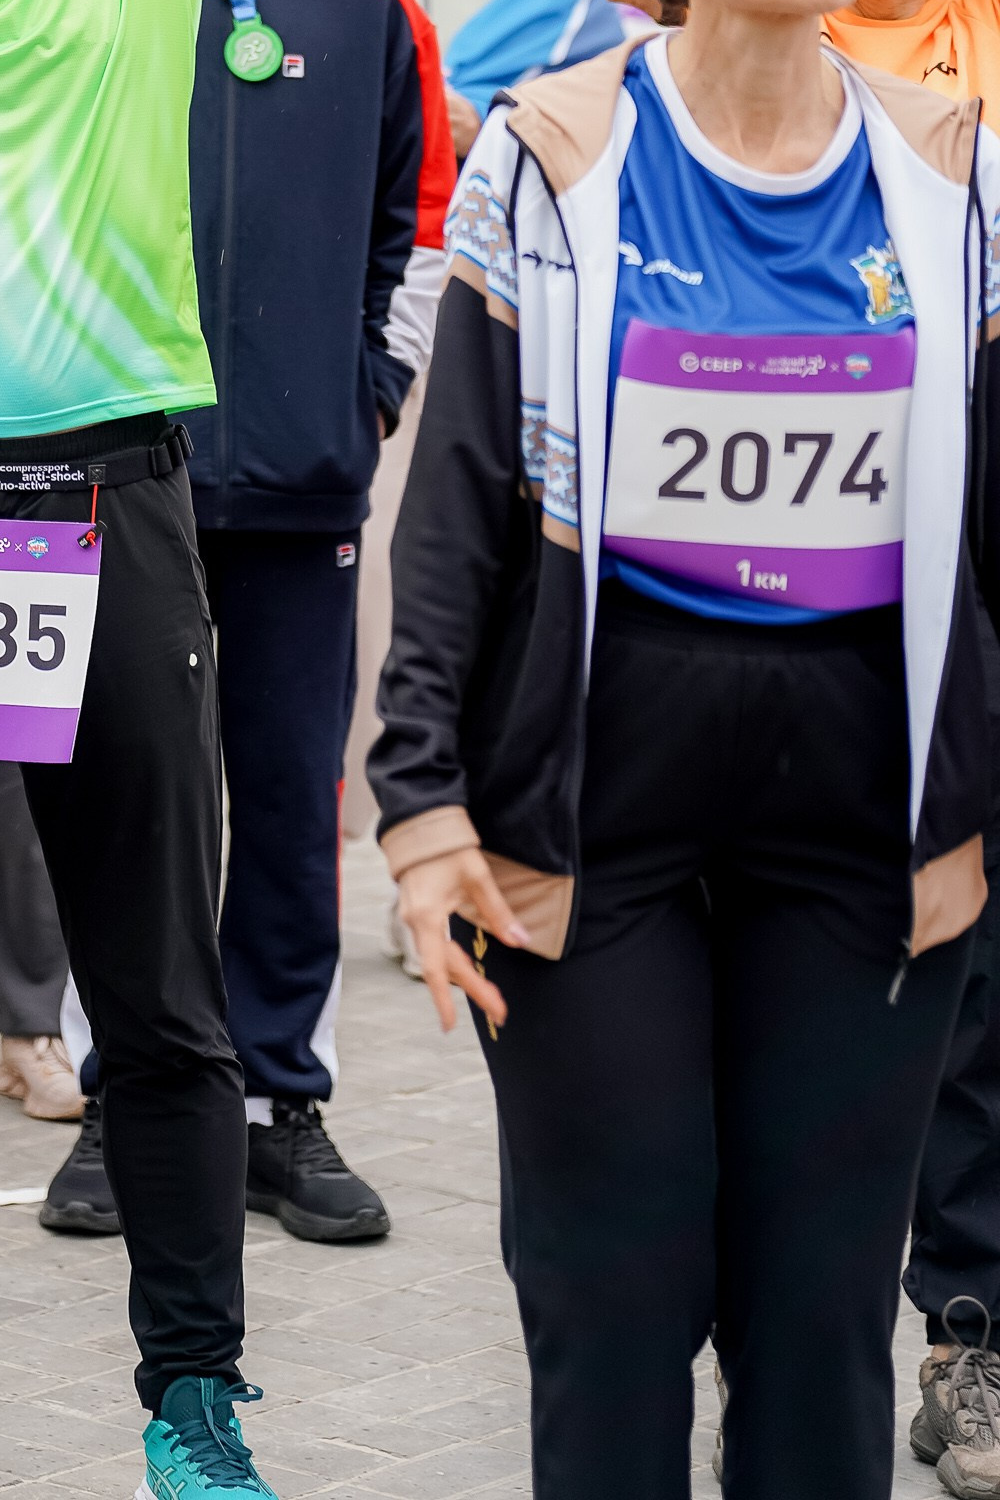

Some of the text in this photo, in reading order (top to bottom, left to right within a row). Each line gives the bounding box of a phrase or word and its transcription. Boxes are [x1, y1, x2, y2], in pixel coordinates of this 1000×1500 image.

[0, 464, 70, 474] compressport
[658, 428, 888, 507] 2074
[22, 470, 85, 482] anti-shock
